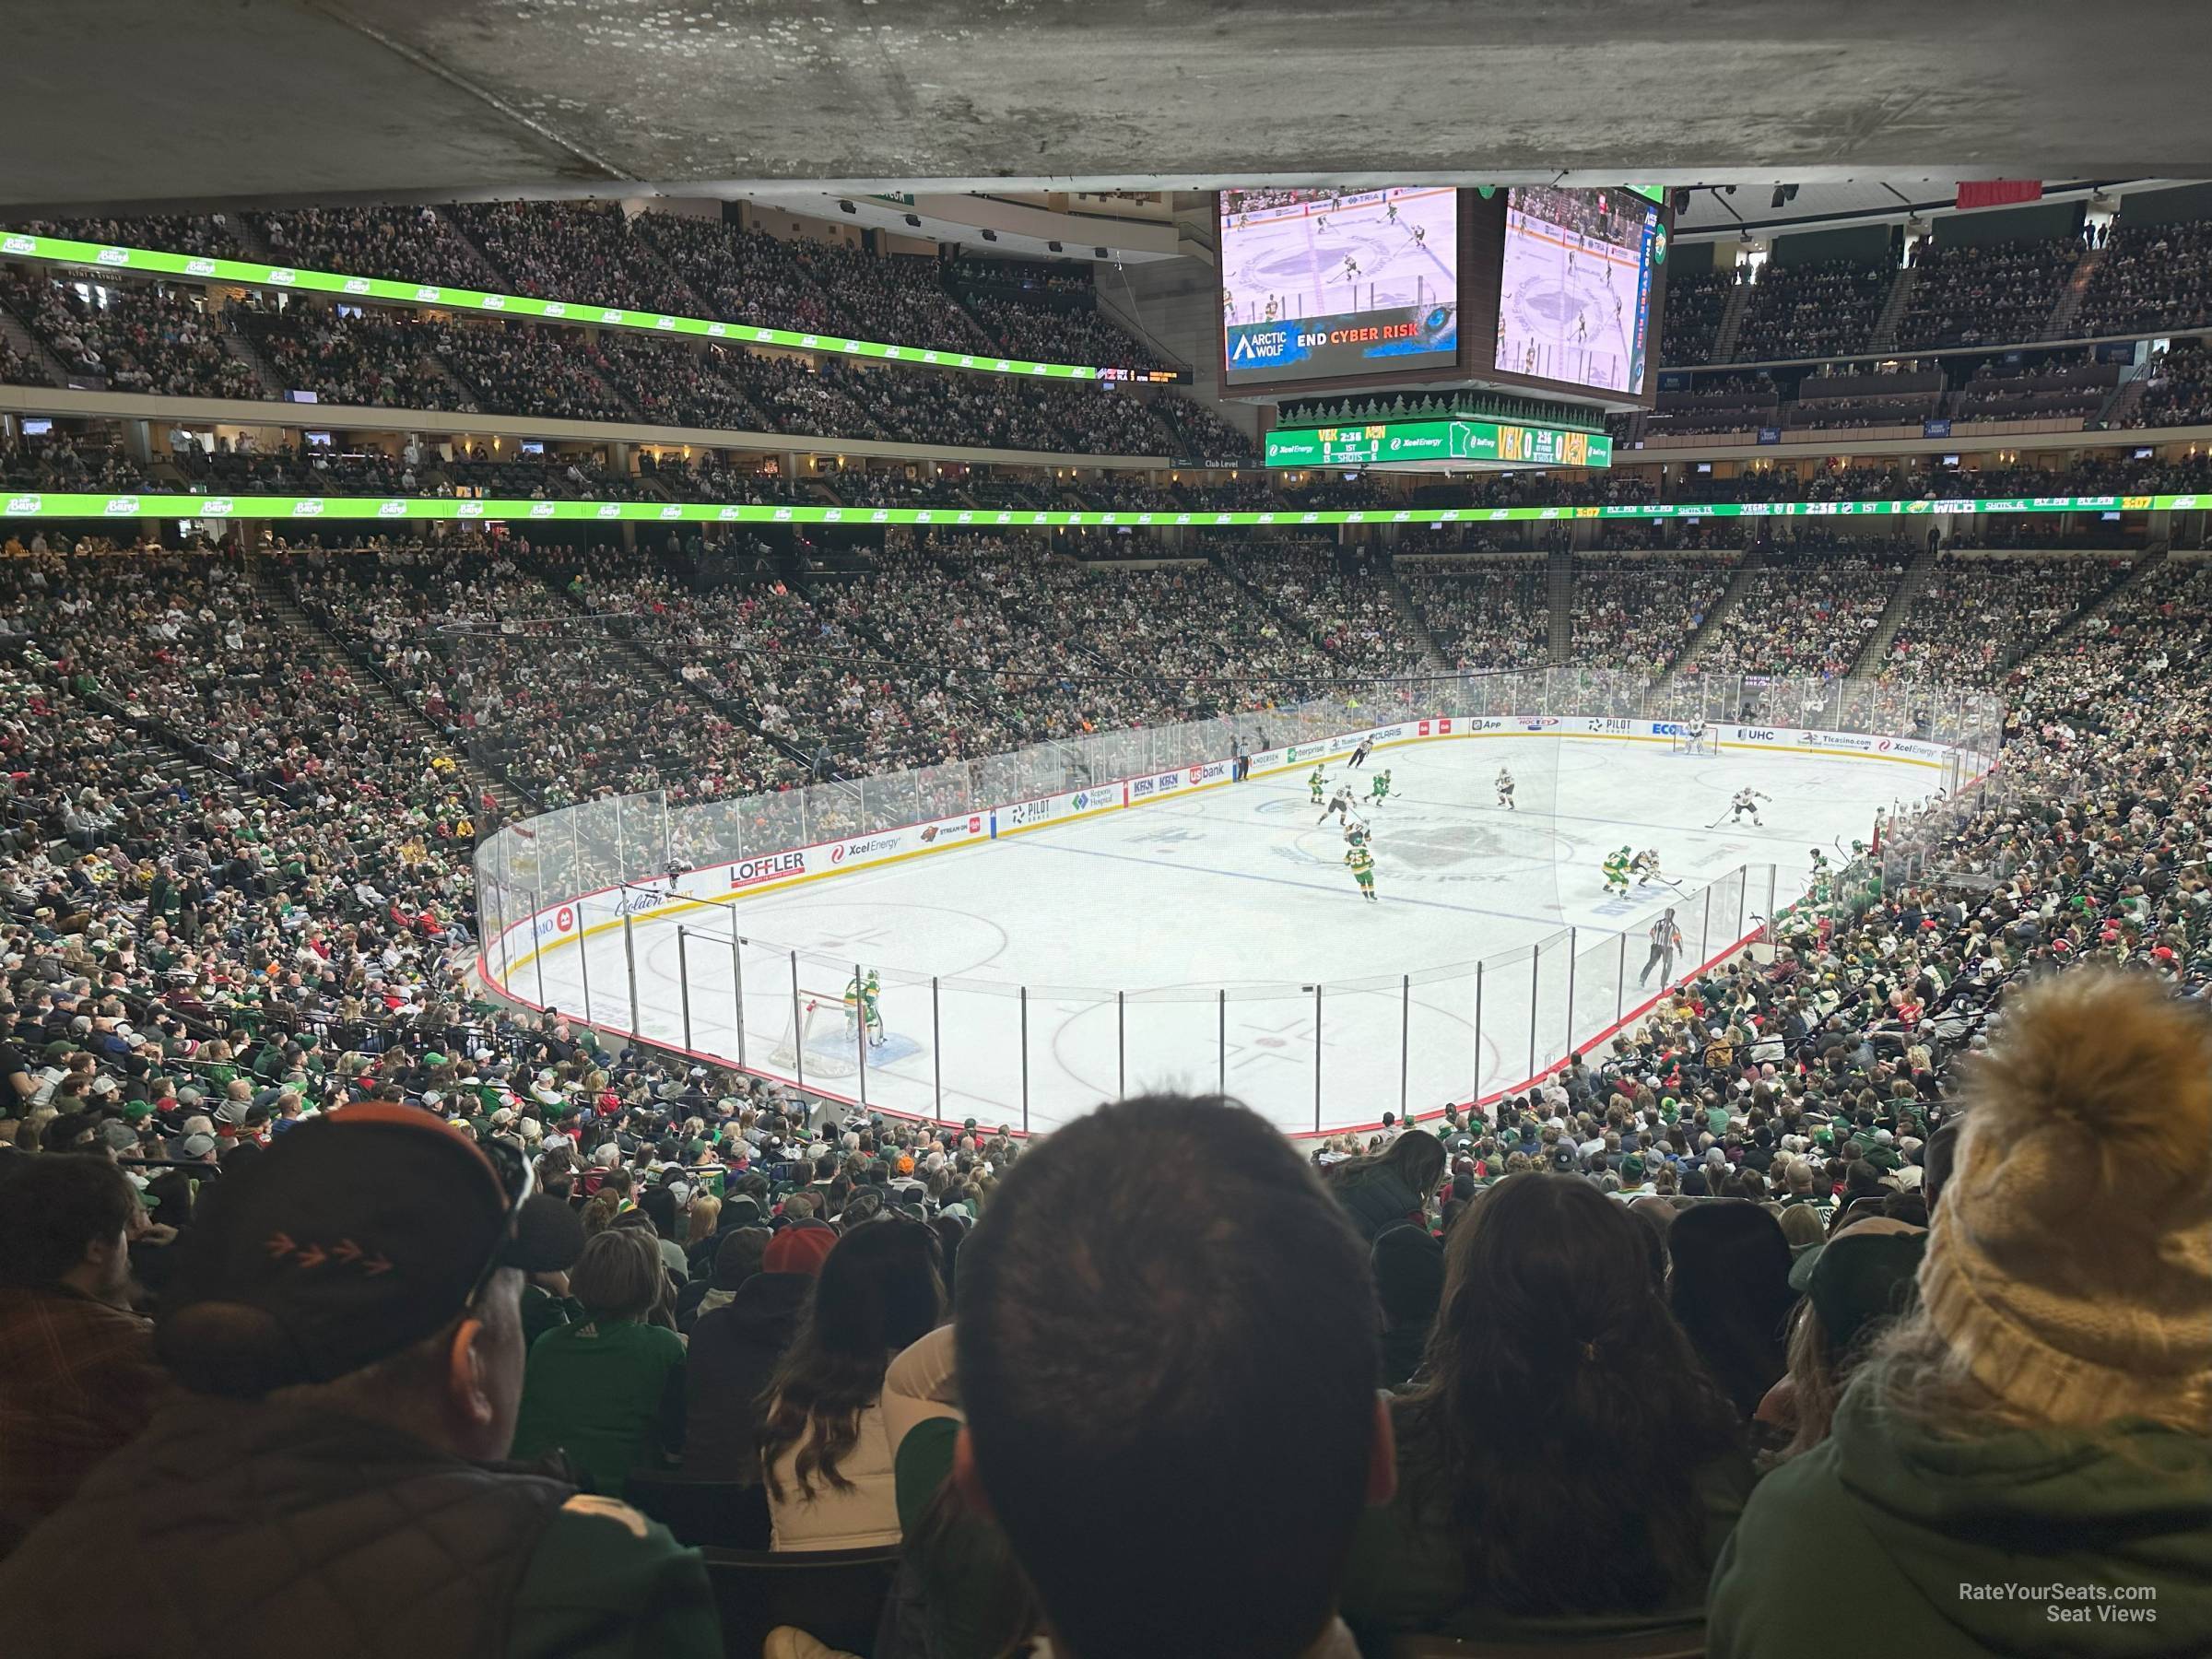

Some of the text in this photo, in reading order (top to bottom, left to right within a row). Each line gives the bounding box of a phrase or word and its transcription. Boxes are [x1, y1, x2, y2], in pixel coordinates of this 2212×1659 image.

[1359, 194, 1379, 202] TRIA
[1252, 332, 1287, 346] ARCTIC
[1298, 324, 1419, 347] END CYBER RISK
[1256, 345, 1284, 358] WOLF
[1340, 432, 1361, 441] 2:36
[1206, 460, 1239, 468] Club Level
[1337, 453, 1363, 463] SHOTS
[1743, 503, 1769, 512] VEGAS
[1786, 503, 1795, 514] 0
[1806, 503, 1837, 514] 2:36
[1863, 503, 1878, 512] 1ST
[1892, 501, 1900, 513] 0
[1934, 503, 1976, 513] WILD
[2123, 498, 2151, 509] 3:07
[1606, 719, 1631, 730] PILOT
[1749, 731, 1775, 741] UHC
[1203, 763, 1225, 778] bank
[1028, 799, 1050, 816] PILOT
[940, 825, 960, 835] STREAM
[849, 838, 898, 856] Xcel Energy
[731, 853, 805, 881] LOFFLER
[615, 894, 663, 917] Golden
